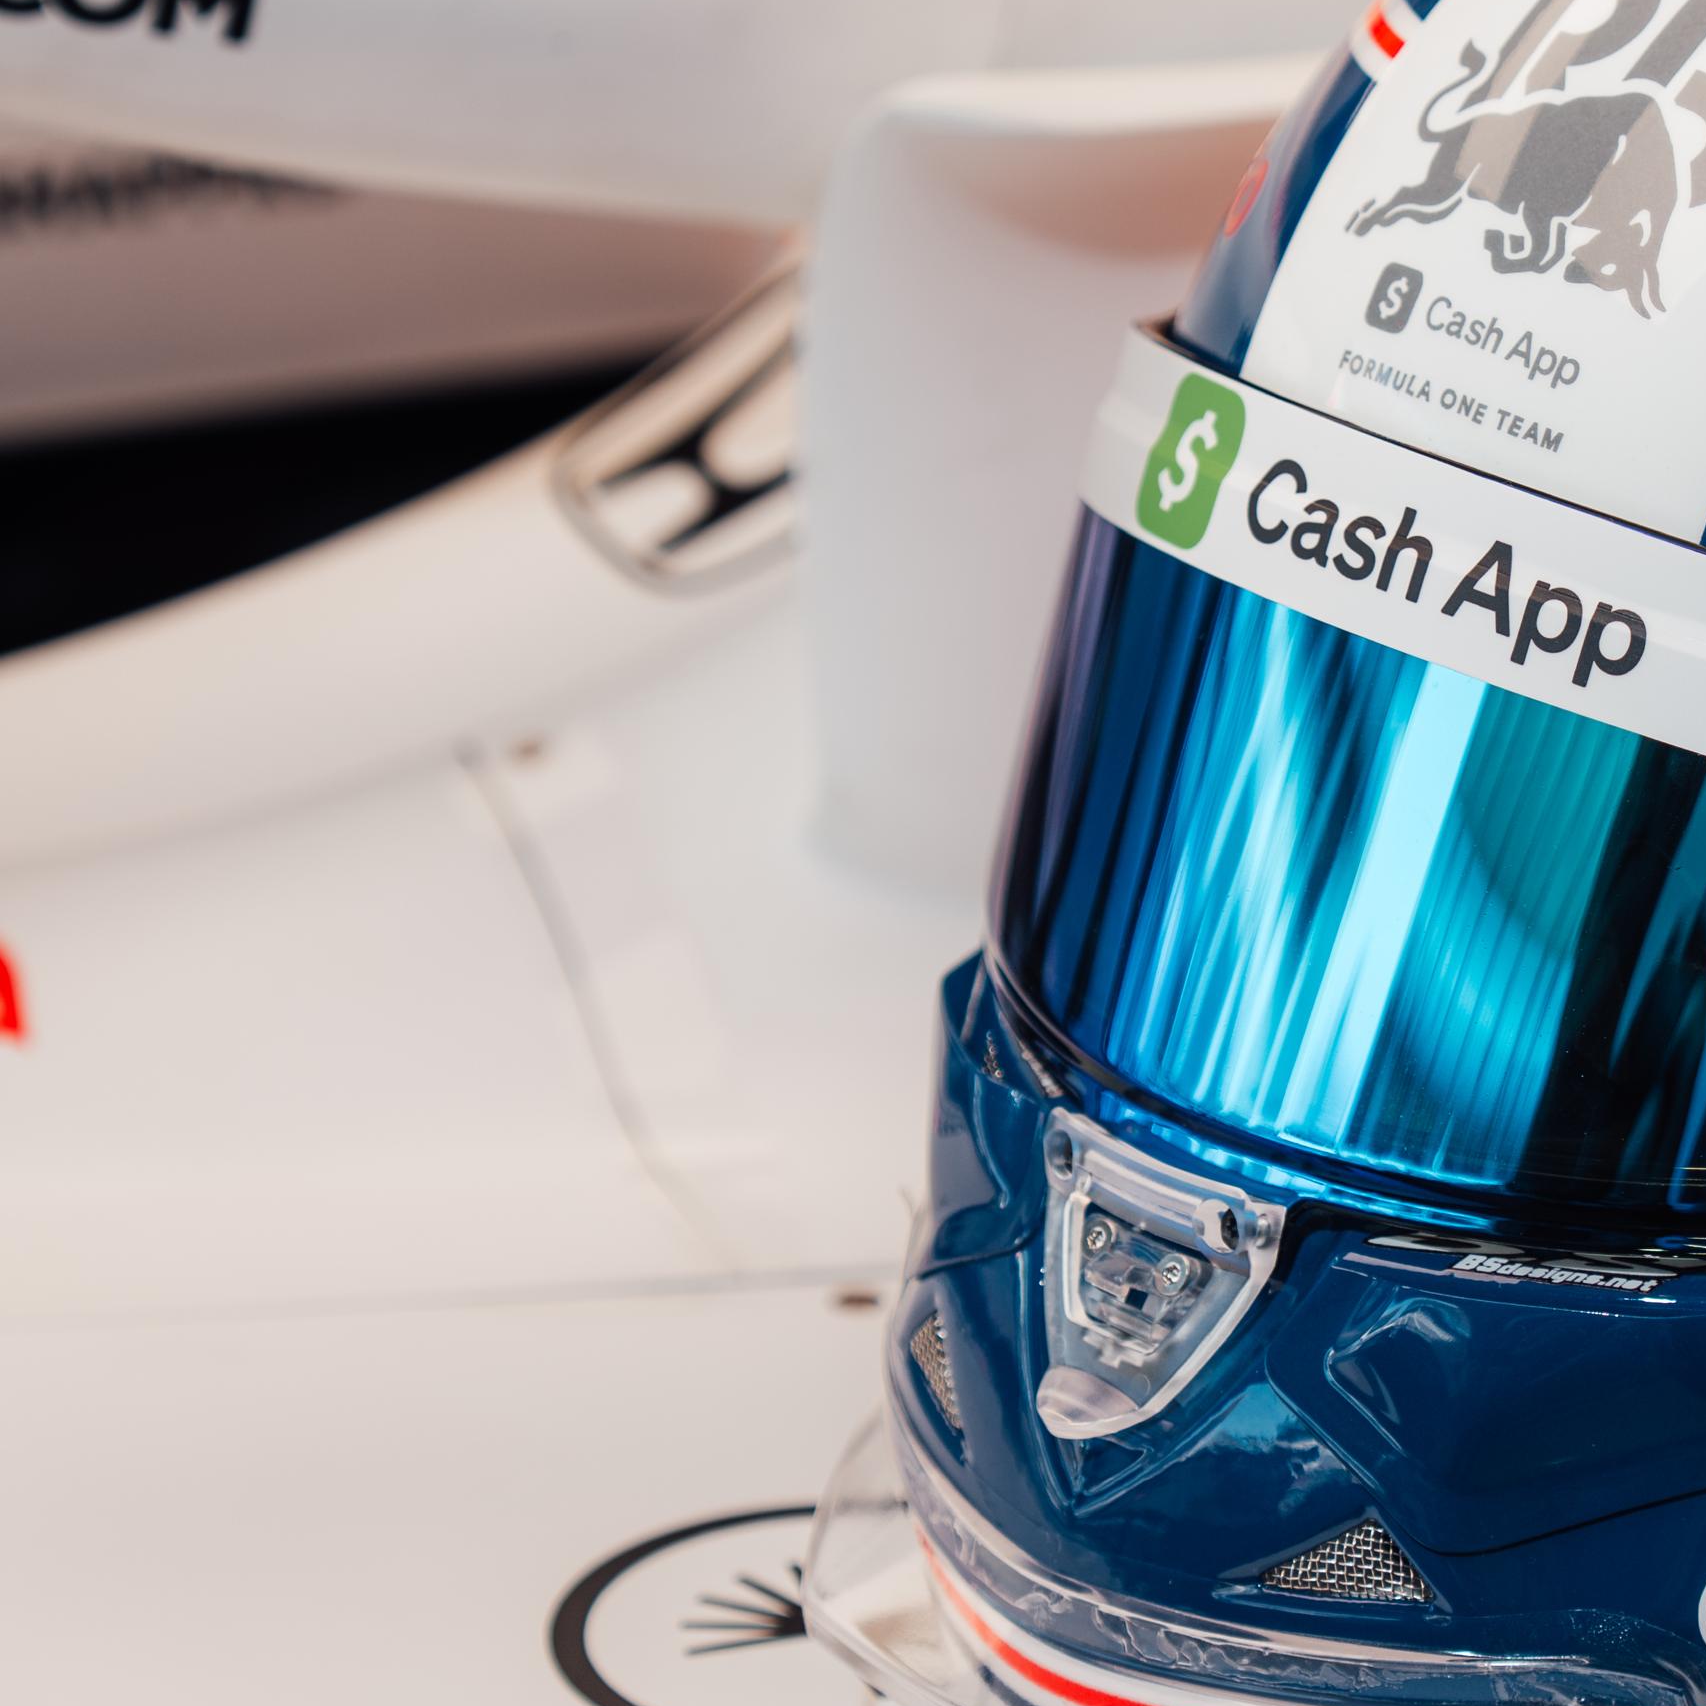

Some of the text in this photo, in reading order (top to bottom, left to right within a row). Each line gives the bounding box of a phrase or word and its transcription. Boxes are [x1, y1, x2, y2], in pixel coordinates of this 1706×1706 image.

[1426, 296, 1504, 354] Cash
[1504, 331, 1581, 389] App
[1338, 350, 1565, 453] FORMULA ONE TEAM
[1246, 459, 1433, 603] Cash
[1441, 540, 1648, 687] App
[1452, 1254, 1658, 1293] BSdesigns.net
